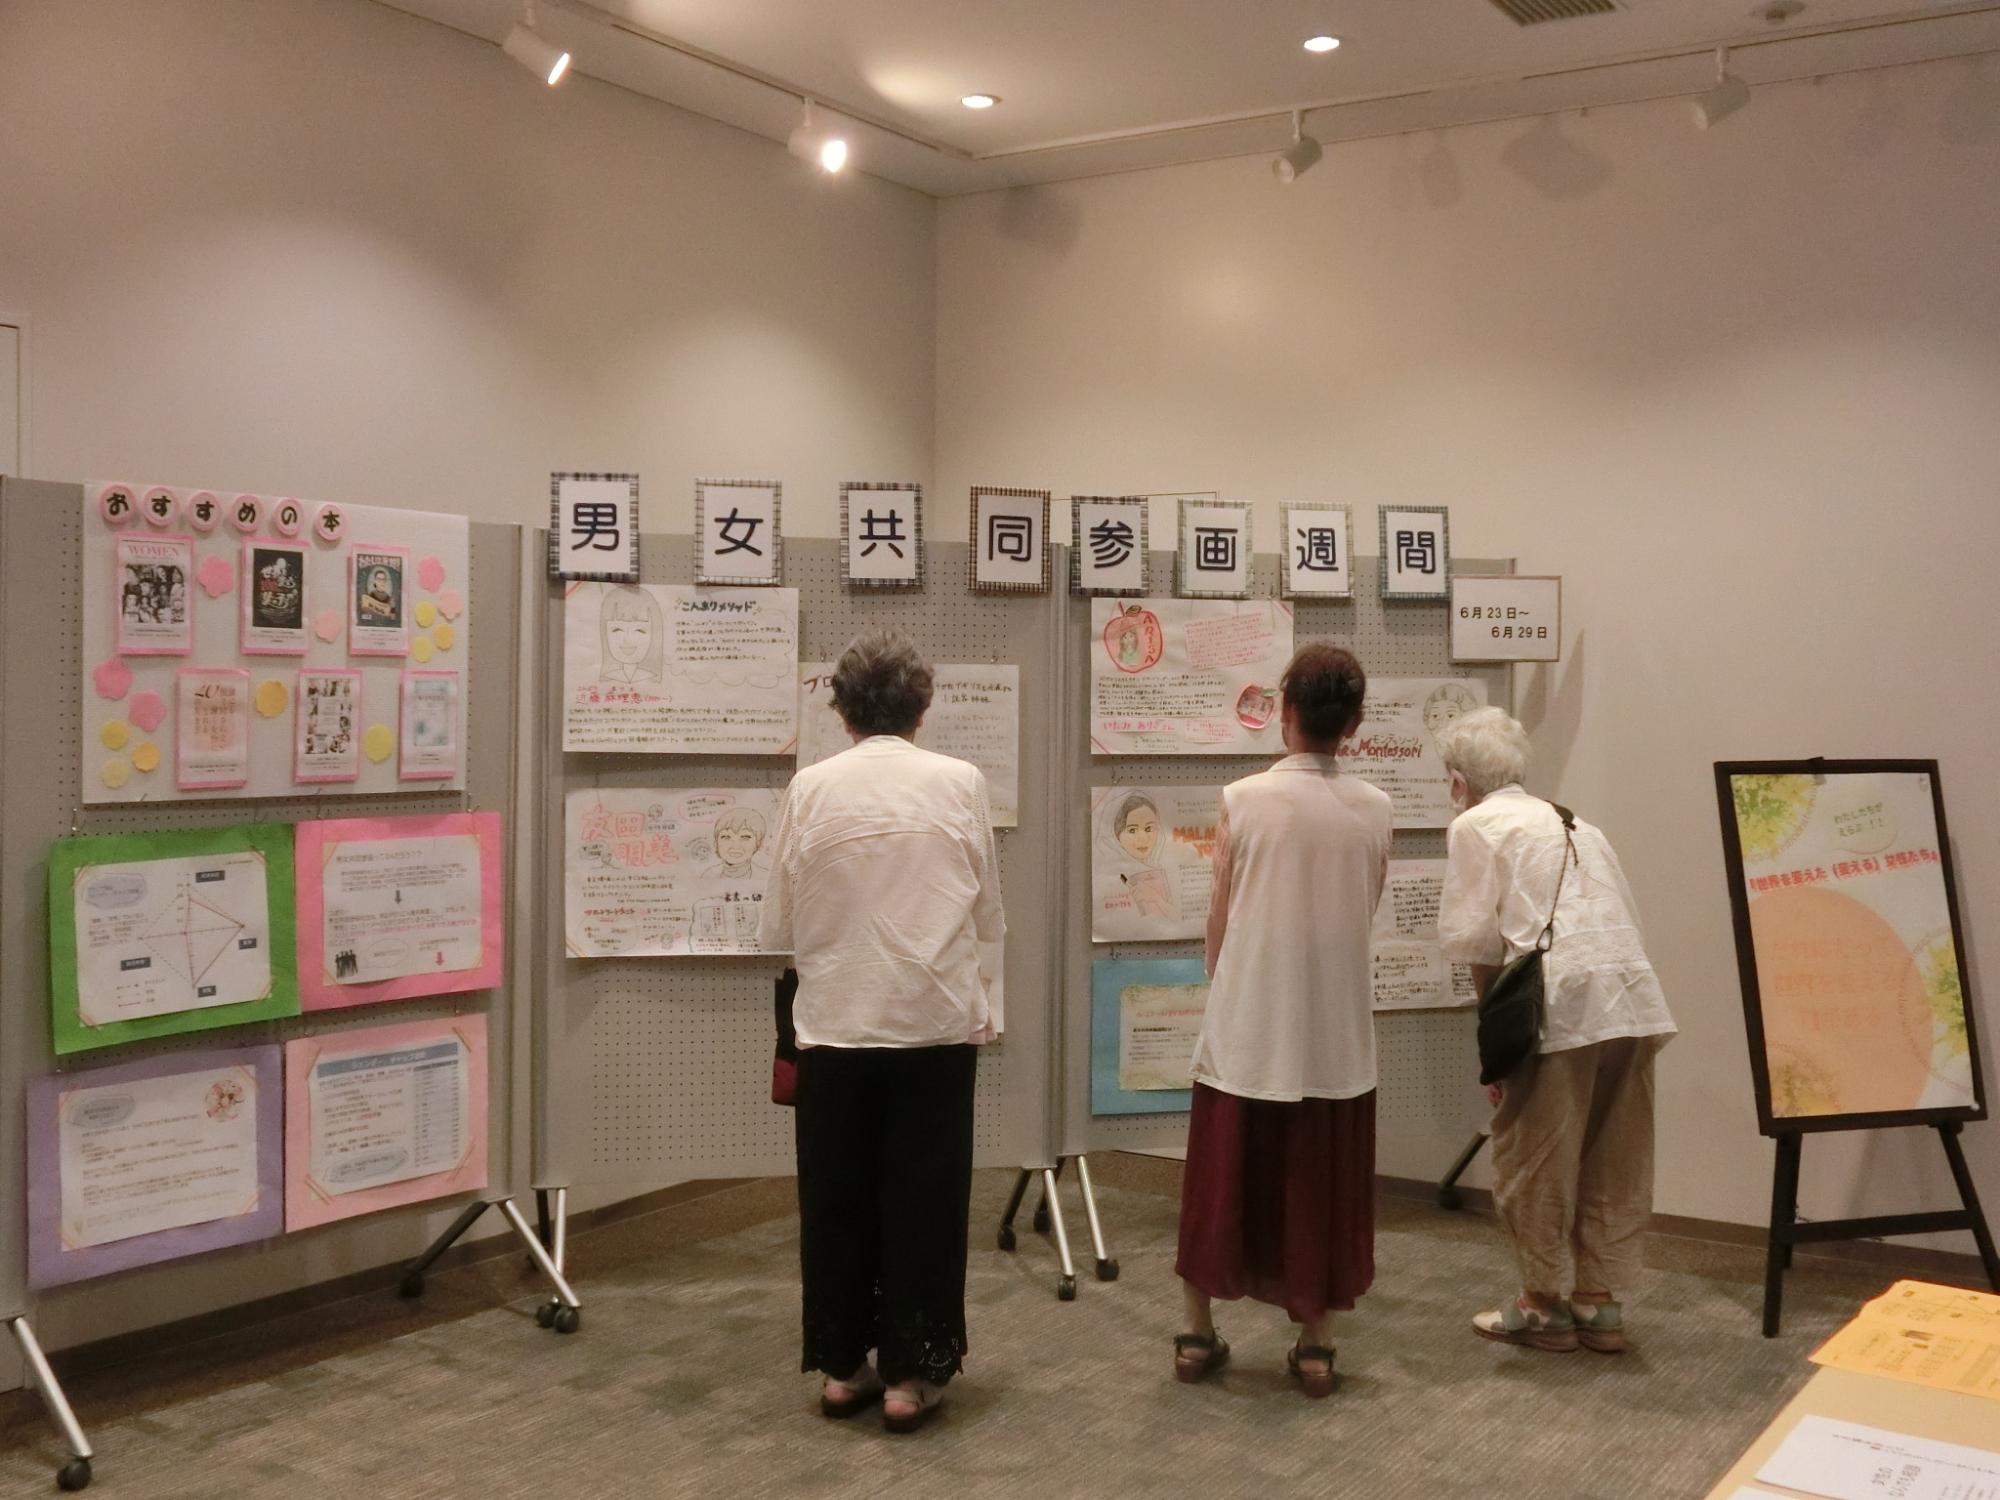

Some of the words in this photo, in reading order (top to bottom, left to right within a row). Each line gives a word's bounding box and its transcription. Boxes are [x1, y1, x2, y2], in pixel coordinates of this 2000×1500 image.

[106, 492, 341, 532] おすすめの本
[1491, 626, 1547, 639] 6月29日
